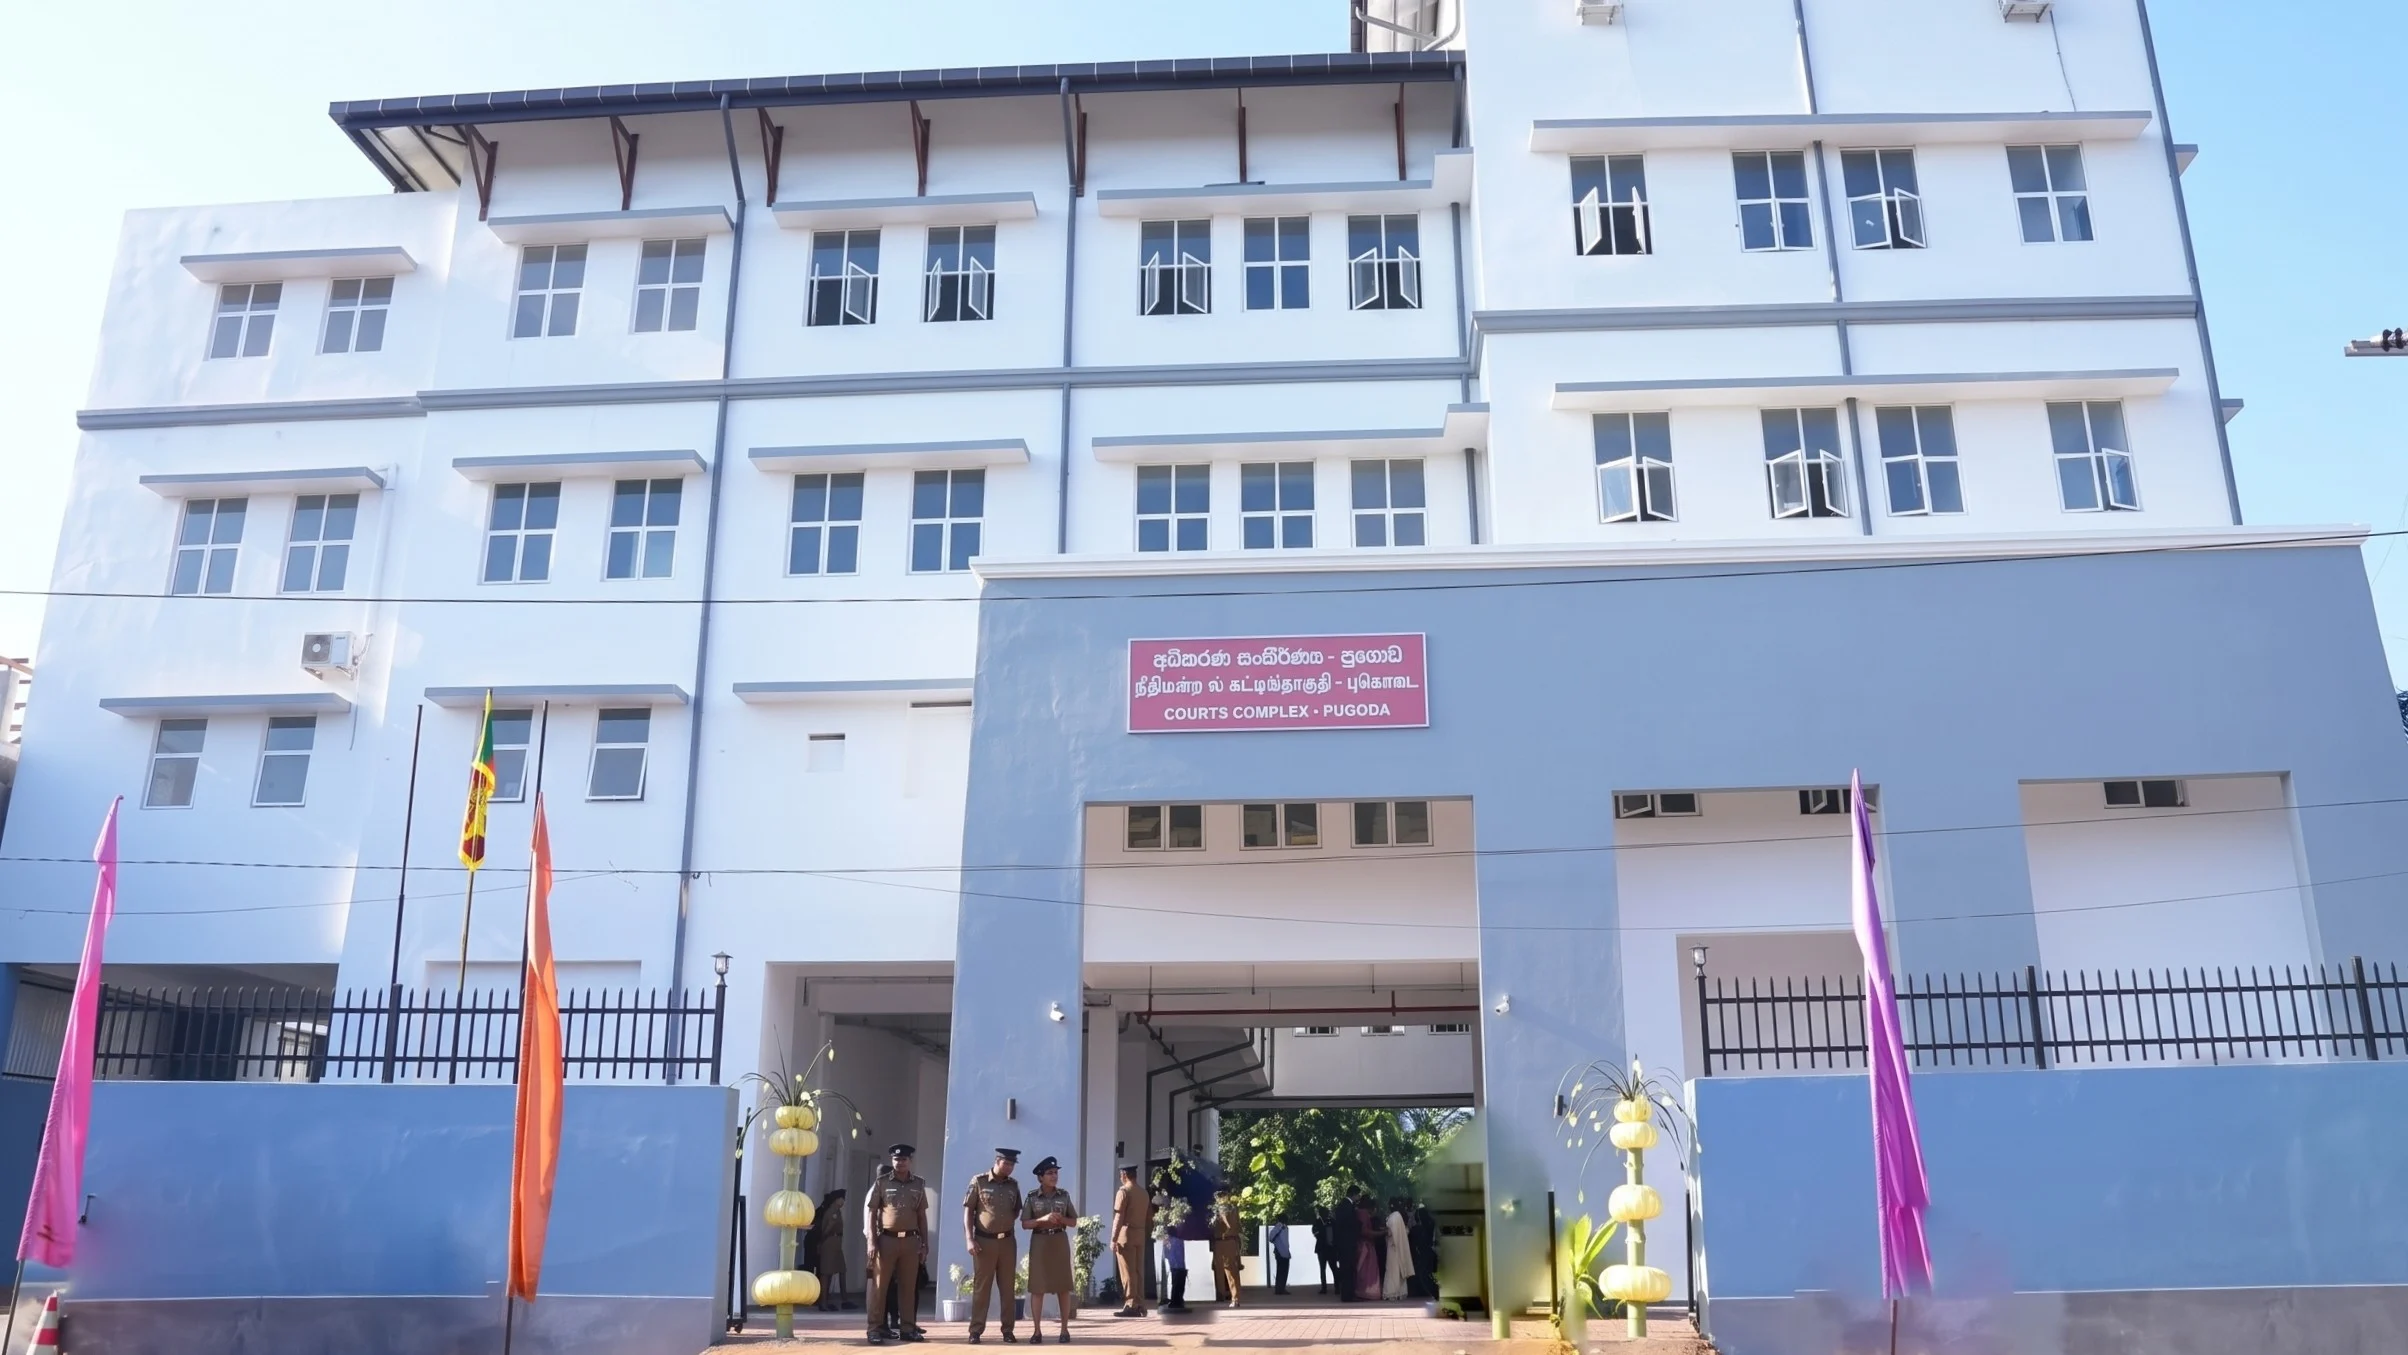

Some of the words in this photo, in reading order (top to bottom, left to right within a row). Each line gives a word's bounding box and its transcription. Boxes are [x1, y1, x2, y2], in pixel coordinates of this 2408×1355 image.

[1153, 648, 1231, 672] අධිකරණ
[1341, 645, 1403, 669] පුගොඩ
[1164, 706, 1228, 721] COURTS
[1233, 704, 1309, 719] COMPLEX
[1323, 703, 1390, 717] PUGODA
